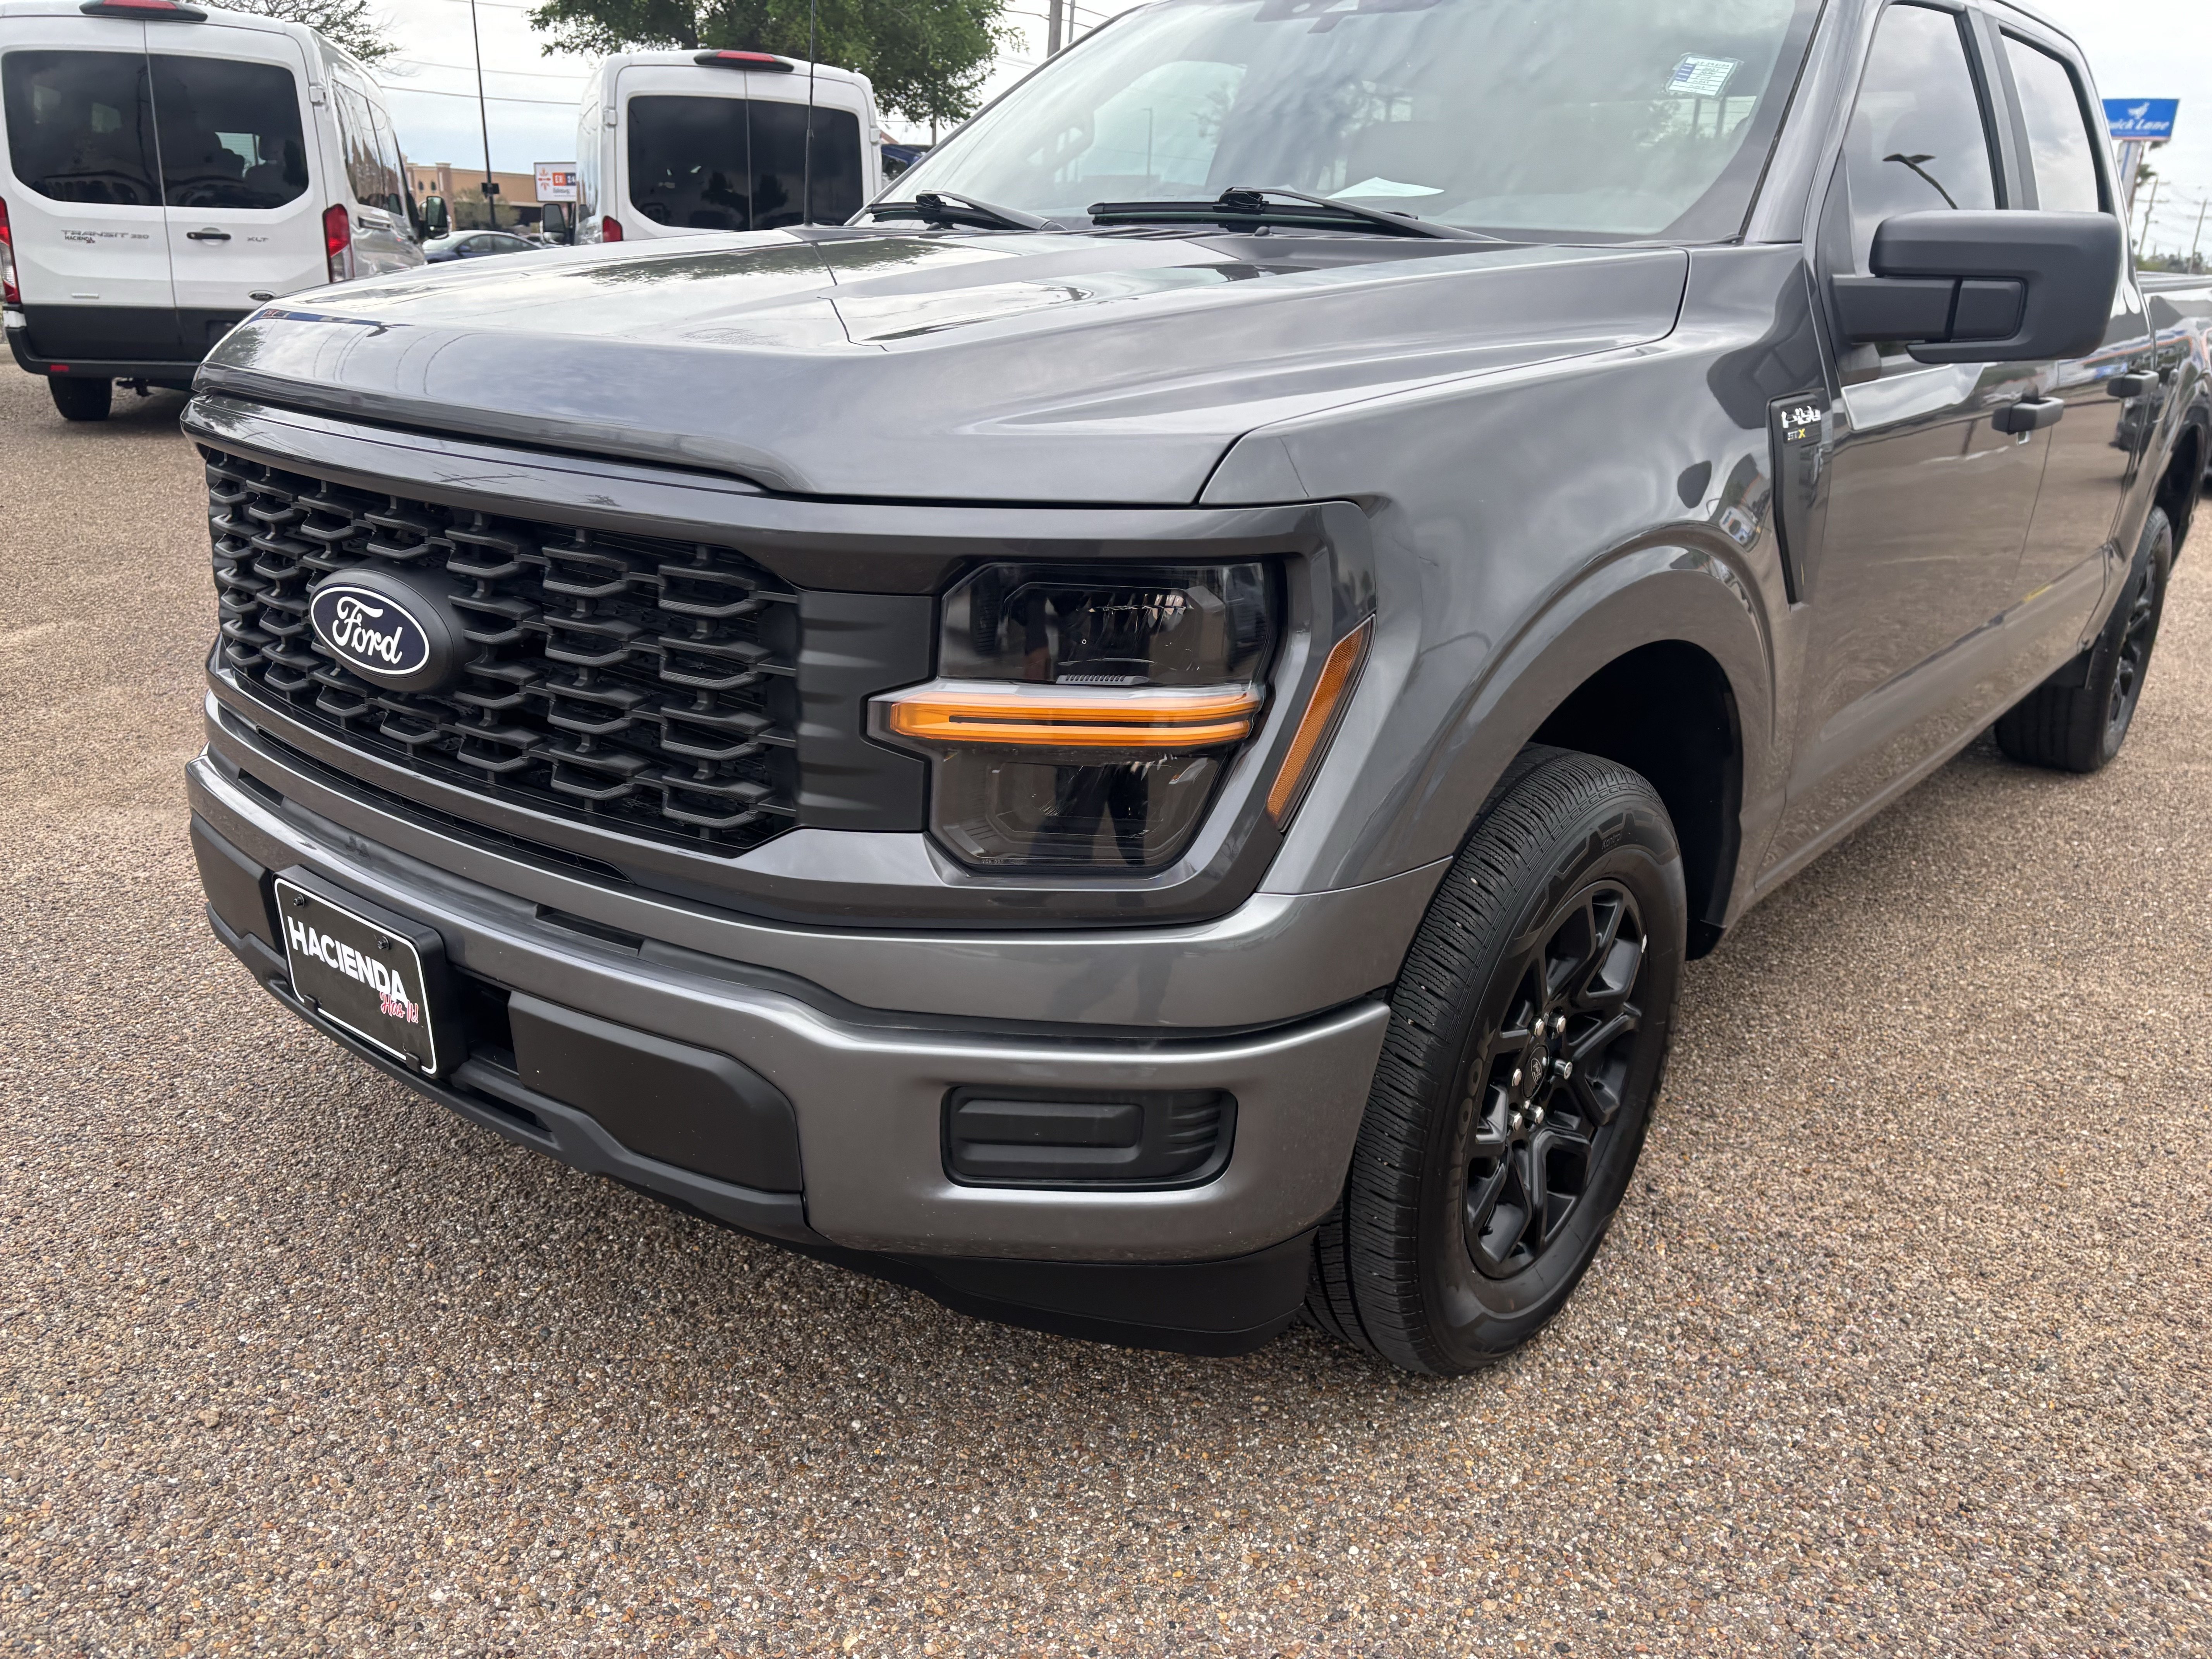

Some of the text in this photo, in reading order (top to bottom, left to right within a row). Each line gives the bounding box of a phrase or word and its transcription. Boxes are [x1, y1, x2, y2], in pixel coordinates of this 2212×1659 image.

[2107, 118, 2170, 131] uick Lane
[61, 230, 129, 238] TRANSIT
[1787, 428, 1806, 441] STX
[332, 596, 403, 664] Ford
[287, 915, 409, 1005] HACIENDA
[379, 991, 419, 1024] Has It!
